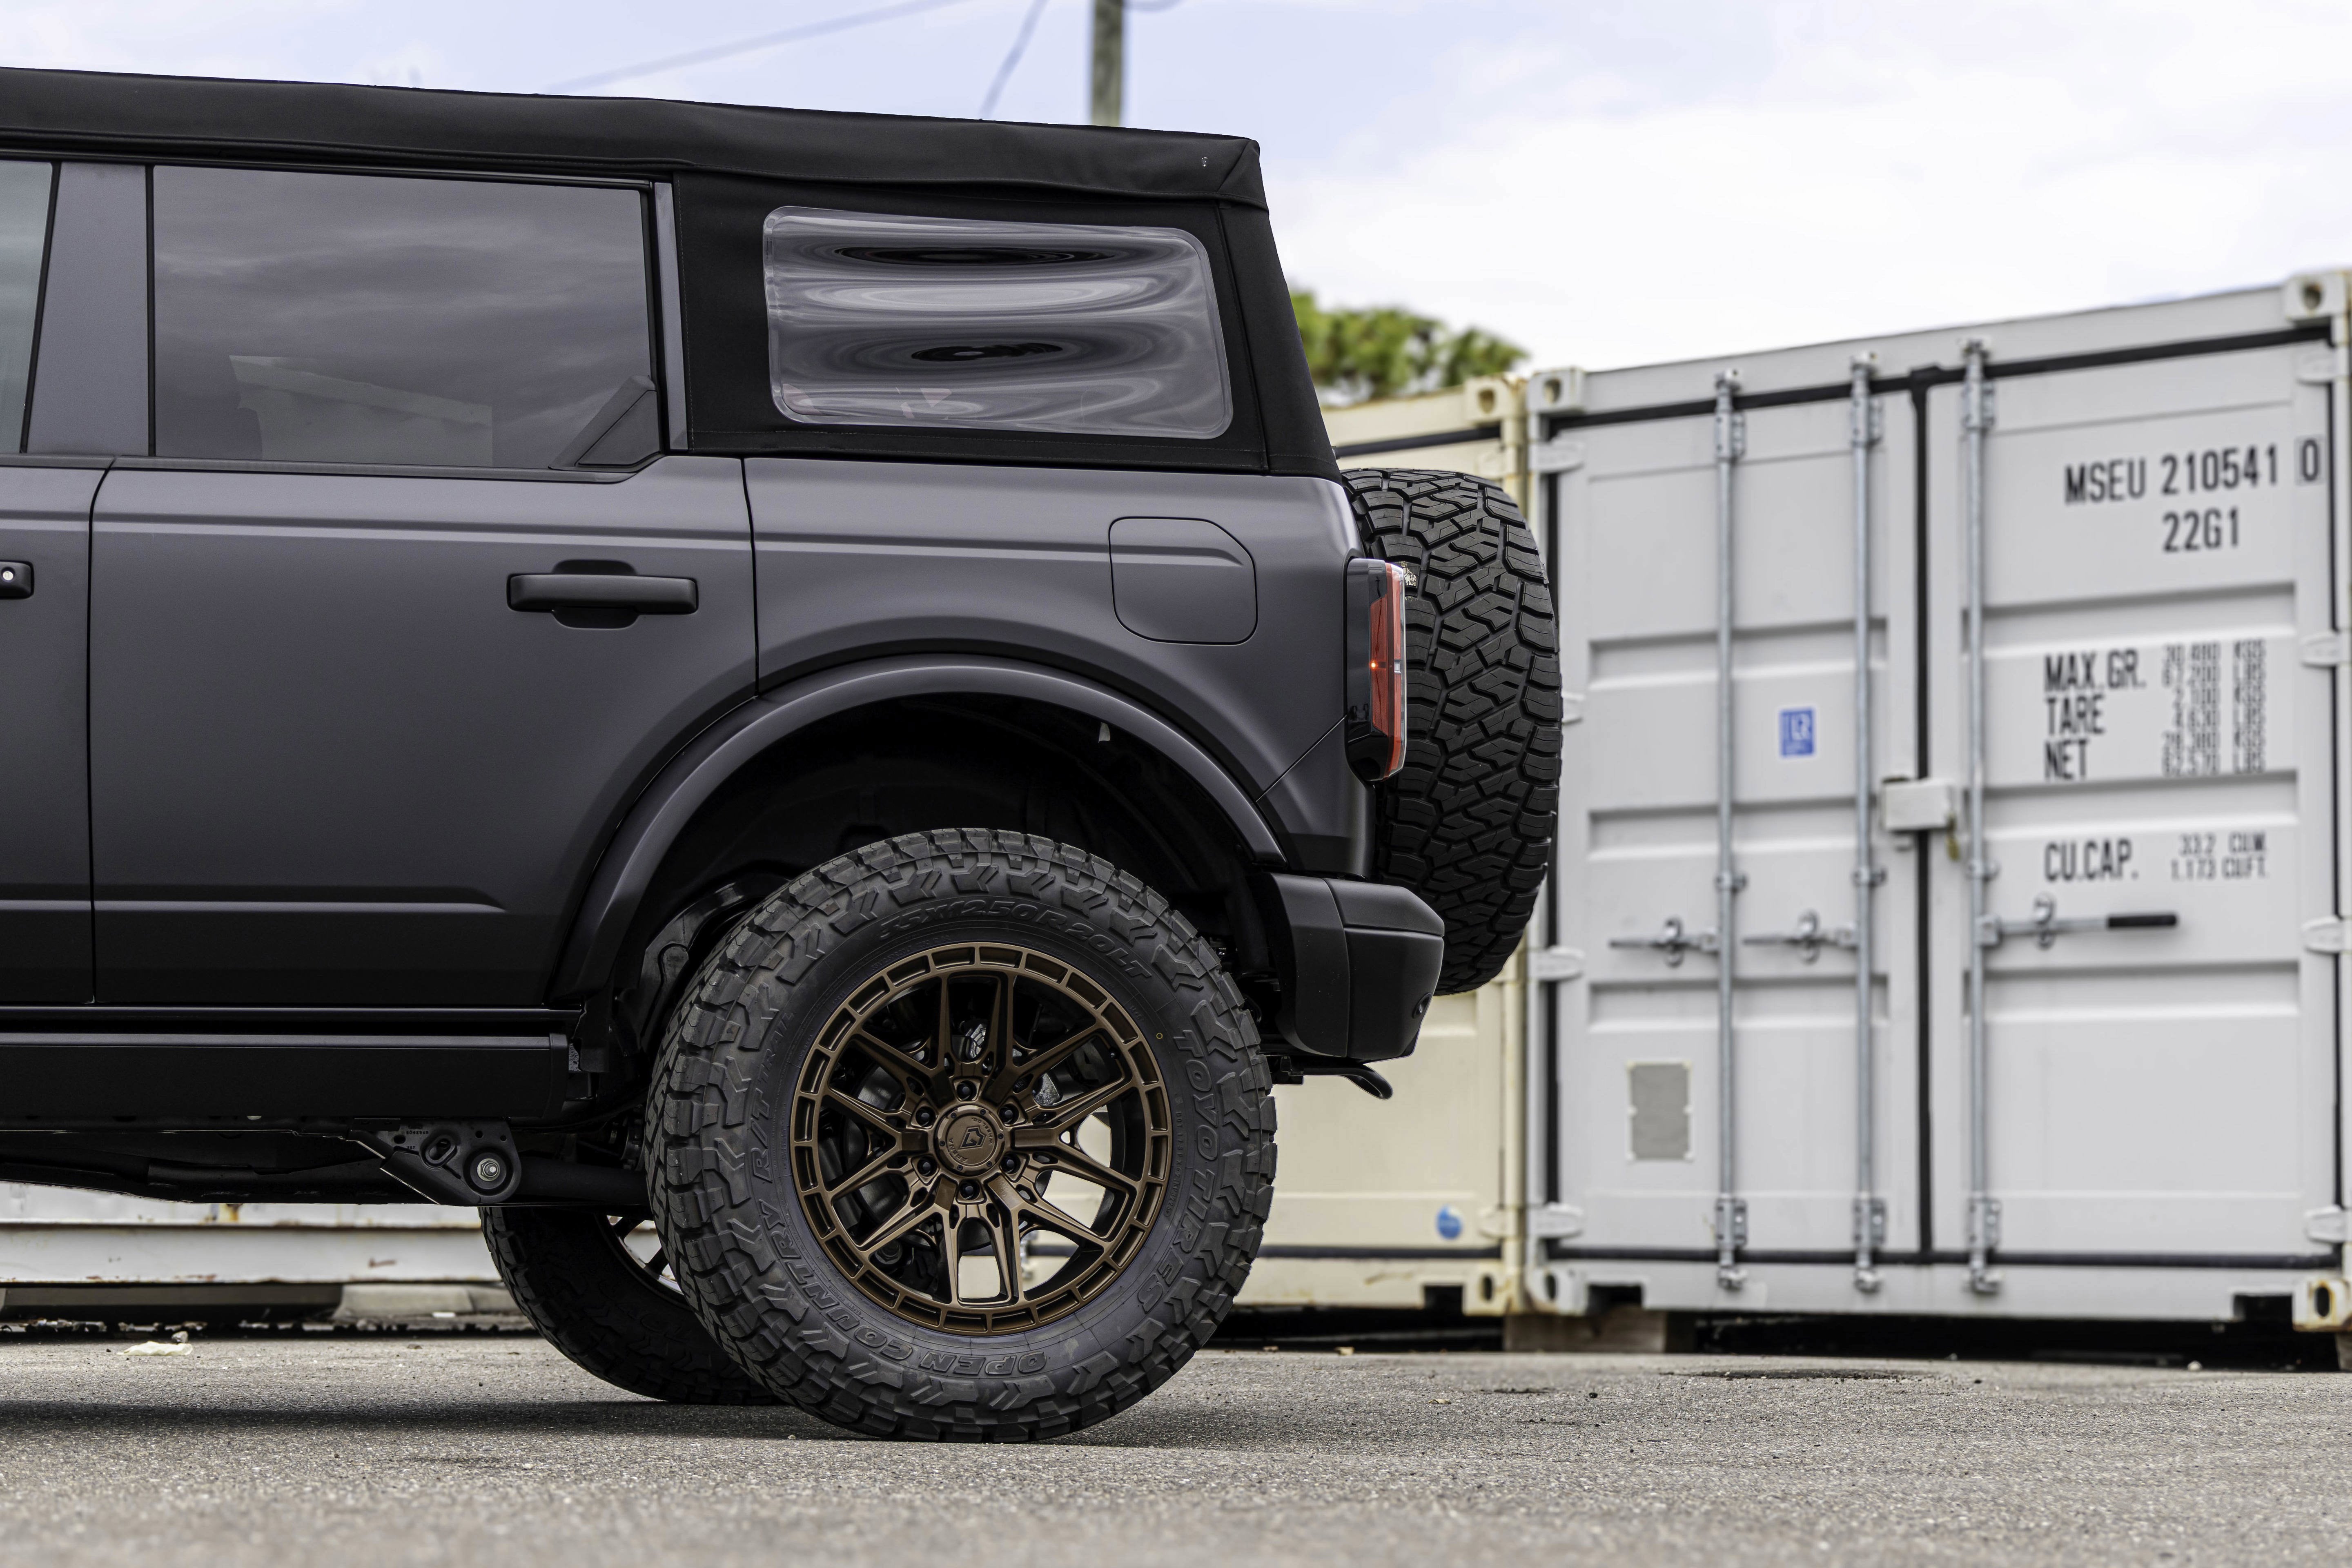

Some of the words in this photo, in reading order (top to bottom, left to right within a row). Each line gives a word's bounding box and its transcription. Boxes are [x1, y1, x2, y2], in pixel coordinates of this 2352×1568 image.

[2064, 457, 2146, 506] MSEU
[2160, 443, 2277, 495] 210541
[2163, 506, 2239, 554] 22G1
[2044, 695, 2105, 736] TARE
[2044, 739, 2087, 780] NET
[1174, 1029, 1217, 1160] TOYO
[751, 1087, 774, 1183] R/T
[1137, 1169, 1216, 1314] TIRES
[759, 1201, 913, 1363] COUNTRY
[920, 1350, 1048, 1379] OPEN
